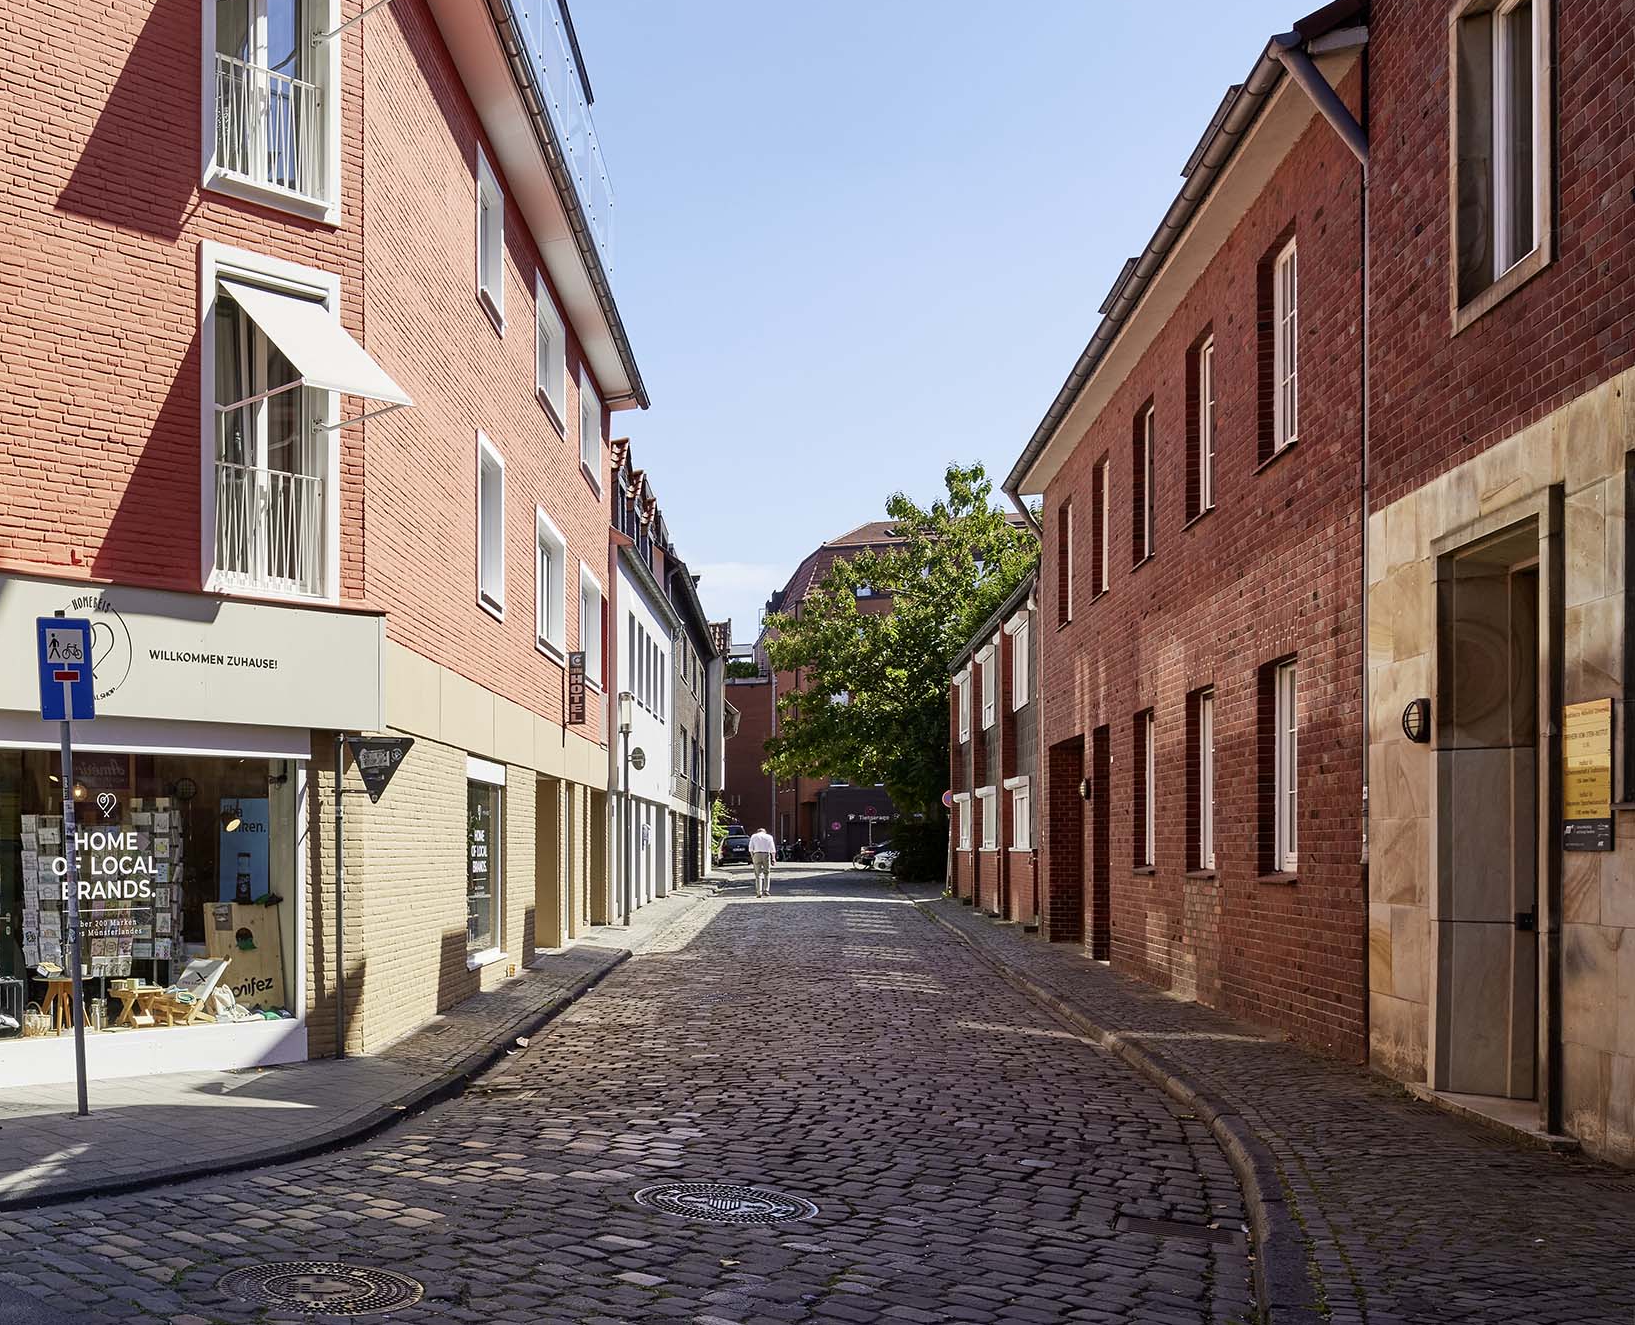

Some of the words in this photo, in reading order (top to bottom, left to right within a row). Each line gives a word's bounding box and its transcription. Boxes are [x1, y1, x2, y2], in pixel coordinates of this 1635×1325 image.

[71, 596, 111, 613] HOMEBEIS
[148, 650, 224, 666] WILLKOMMEN
[226, 655, 278, 670] ZUHAUSE!
[570, 674, 583, 723] HOTEL
[74, 832, 138, 851] HOME
[91, 855, 158, 875] LOCAL
[80, 920, 92, 928] ber
[110, 919, 137, 927] Marken
[88, 928, 142, 938] Münsterlandes
